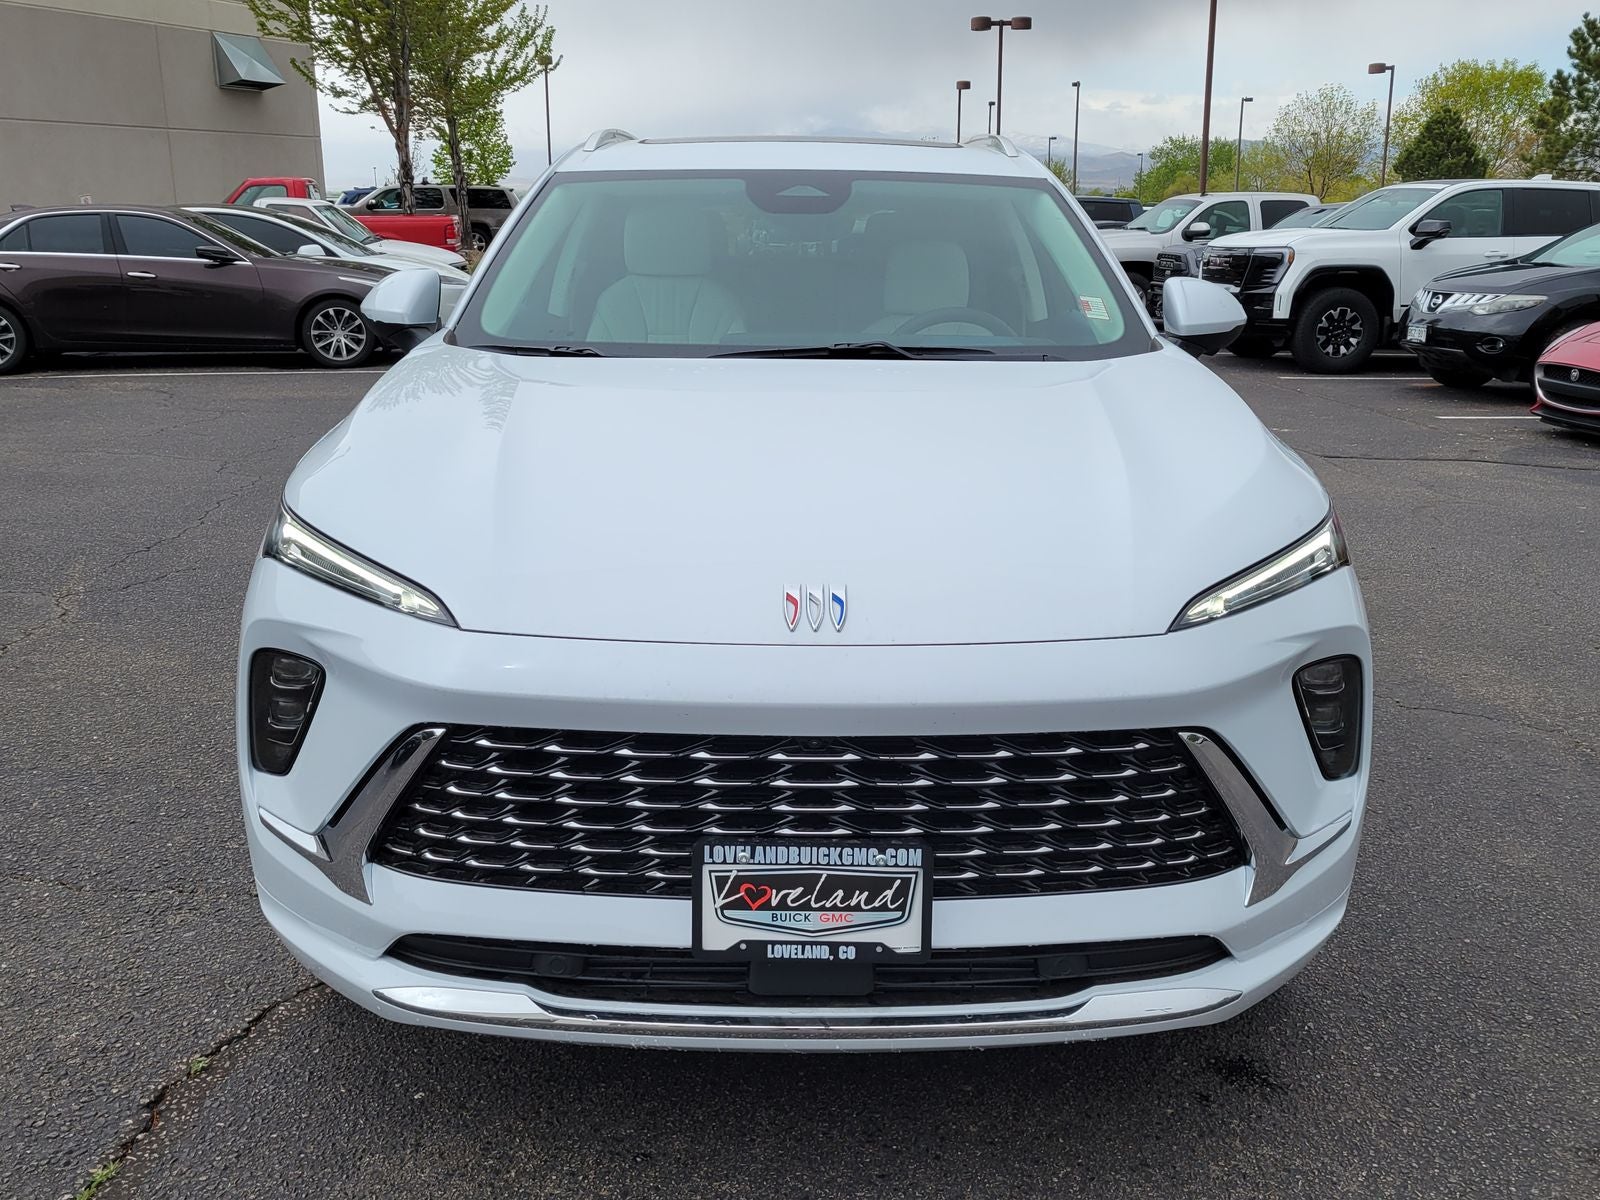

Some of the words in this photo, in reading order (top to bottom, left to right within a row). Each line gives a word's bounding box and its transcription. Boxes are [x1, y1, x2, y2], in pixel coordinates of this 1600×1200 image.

[704, 845, 922, 867] LOVELANDBUICKGMCCOM
[714, 870, 904, 911] Loveland
[771, 913, 812, 923] BUICK
[819, 913, 855, 923] GMC
[767, 944, 834, 961] LOVELAND,
[839, 946, 856, 960] CO
